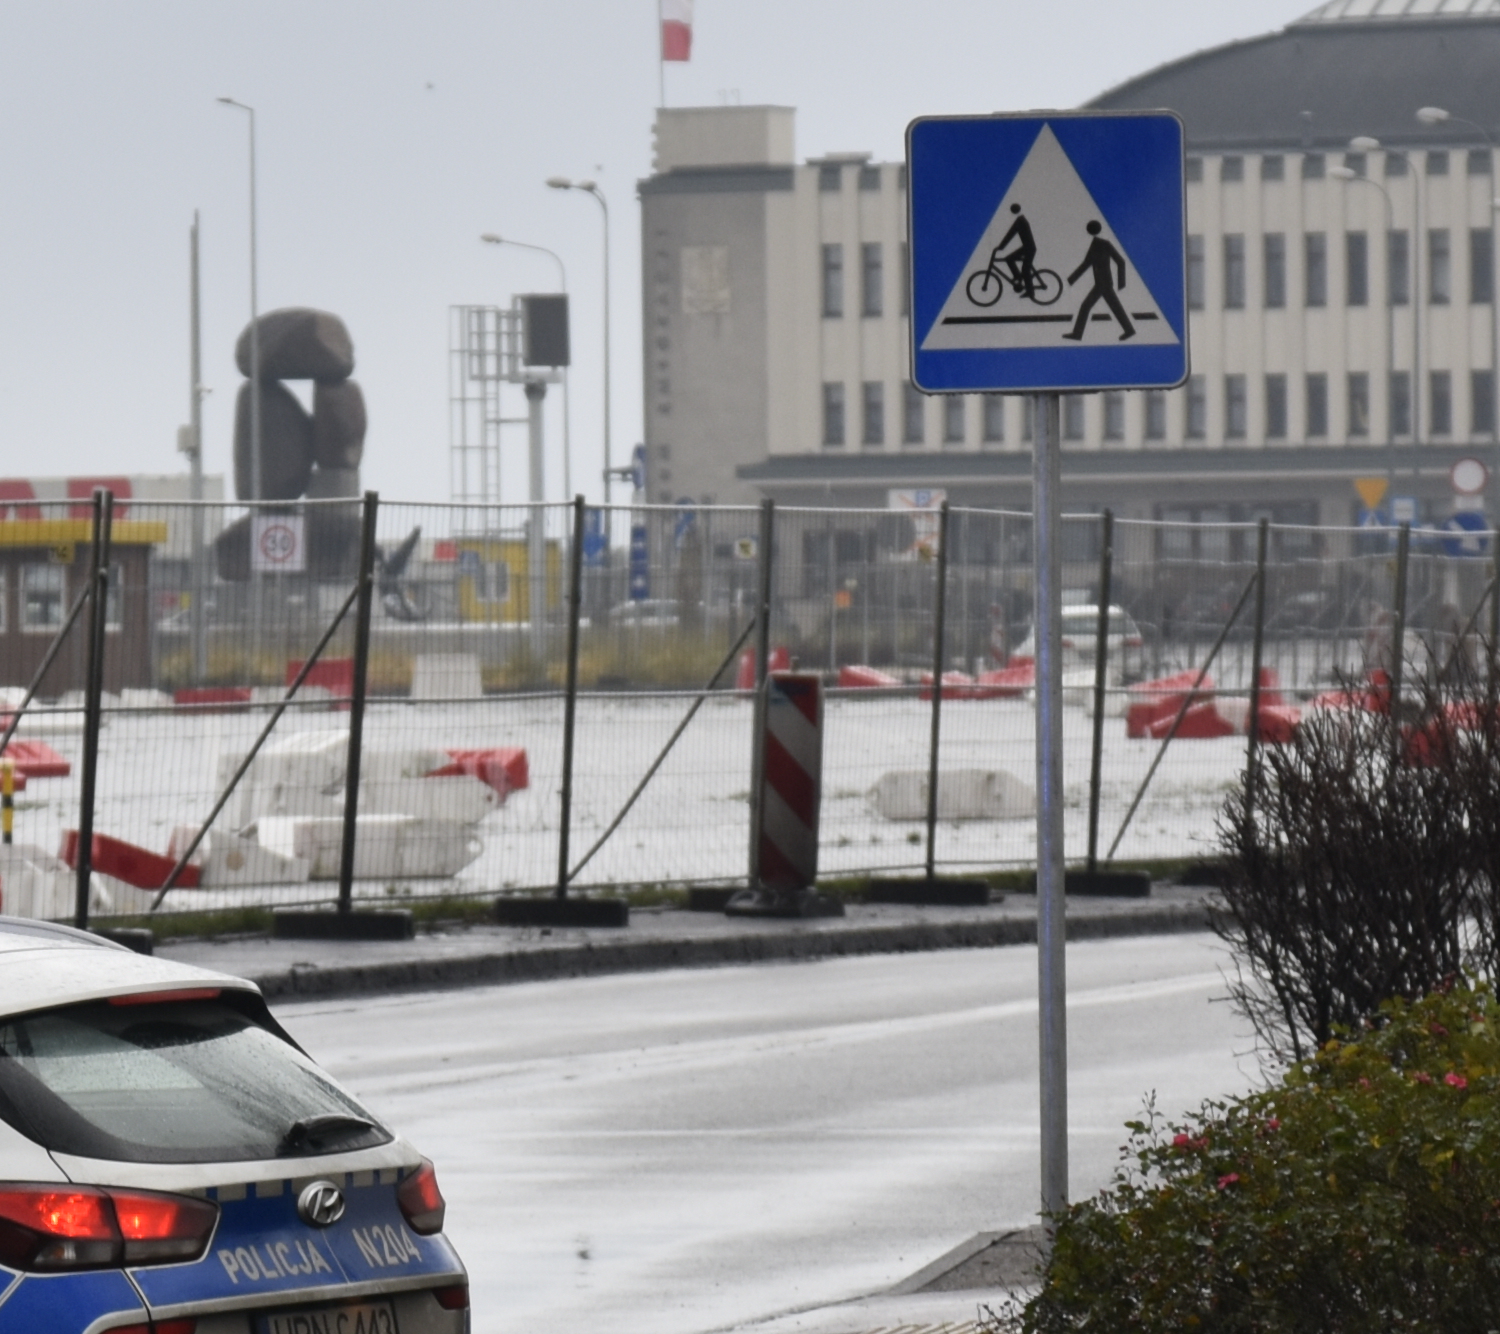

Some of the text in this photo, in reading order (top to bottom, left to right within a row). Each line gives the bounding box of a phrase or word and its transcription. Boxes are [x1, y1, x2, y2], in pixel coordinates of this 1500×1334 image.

[266, 533, 291, 552] 30
[216, 1223, 423, 1285] POLICJA N204
